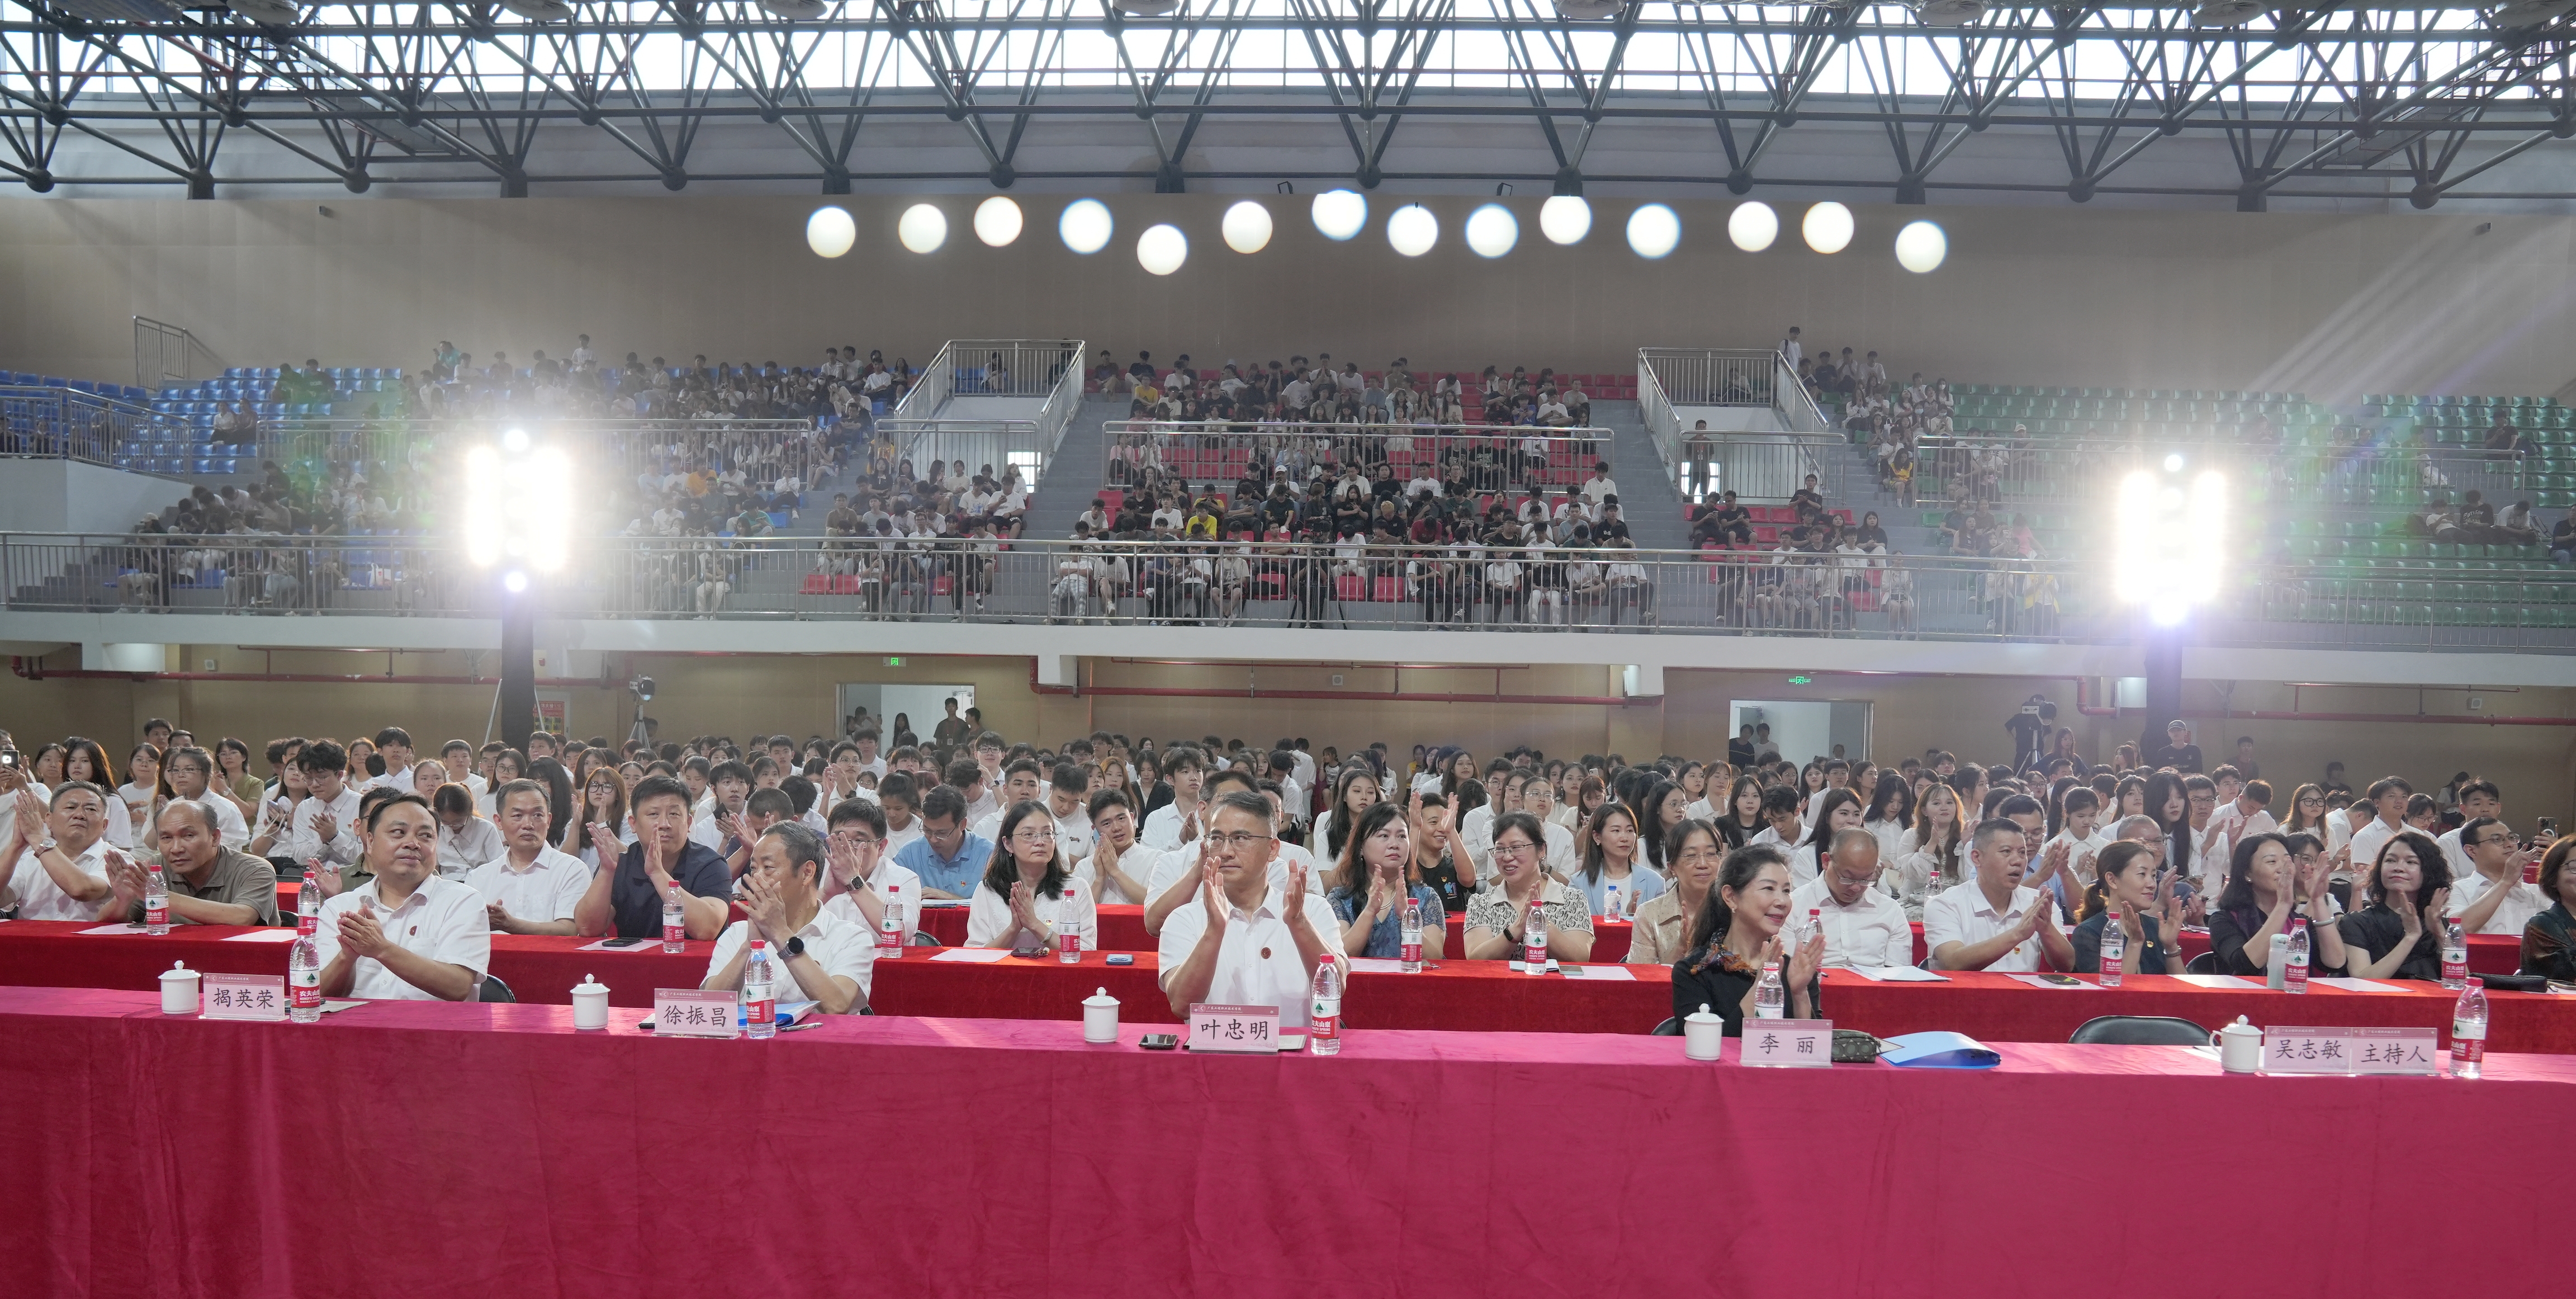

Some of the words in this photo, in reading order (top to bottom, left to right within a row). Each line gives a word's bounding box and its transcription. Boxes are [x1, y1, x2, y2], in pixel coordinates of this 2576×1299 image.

[213, 988, 274, 1009] 揭英荣
[664, 1005, 727, 1027] 徐振昌
[1201, 1018, 1268, 1040] 叶忠明
[2275, 1039, 2343, 1060] 吴志敏
[2361, 1043, 2428, 1065] 主持人
